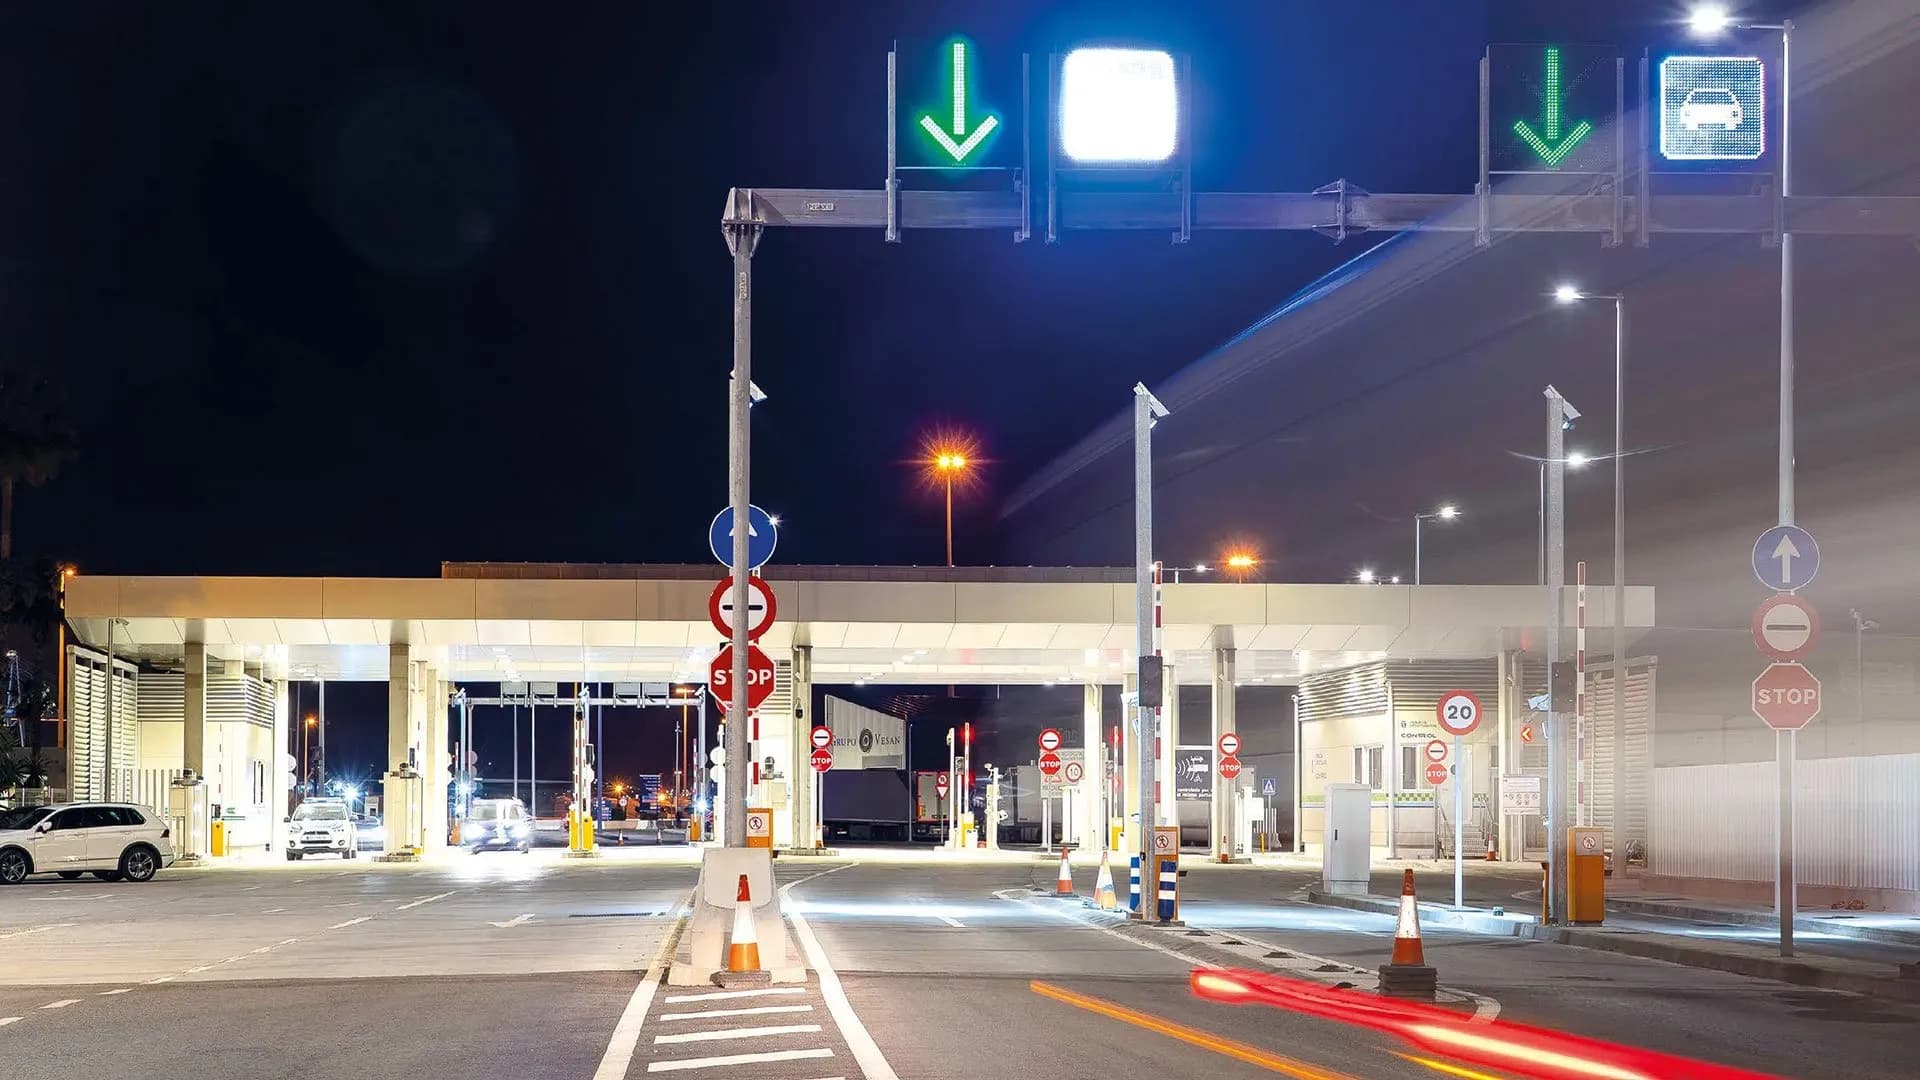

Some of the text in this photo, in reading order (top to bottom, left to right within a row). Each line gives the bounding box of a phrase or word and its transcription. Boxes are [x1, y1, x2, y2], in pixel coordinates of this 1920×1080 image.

[714, 669, 772, 686] SOP
[1758, 688, 1817, 705] STOP
[1447, 705, 1472, 720] 20
